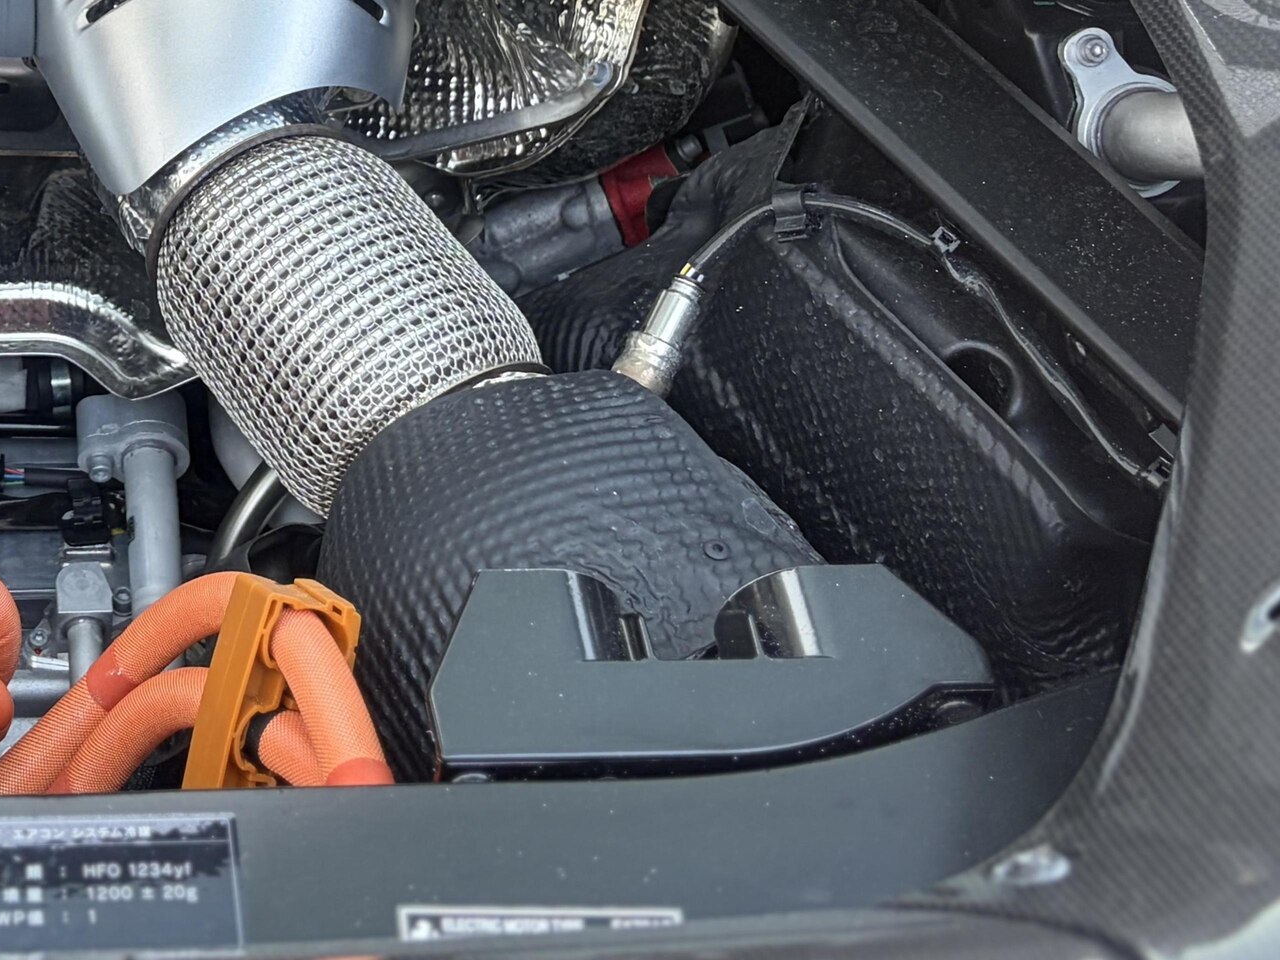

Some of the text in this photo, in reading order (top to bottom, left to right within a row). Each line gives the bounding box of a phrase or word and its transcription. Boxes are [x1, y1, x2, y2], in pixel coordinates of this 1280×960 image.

[82, 863, 122, 879] HFO
[128, 862, 193, 879] 1234yf
[87, 886, 133, 901] 1200
[163, 885, 198, 903] 20g
[87, 910, 97, 924] 1
